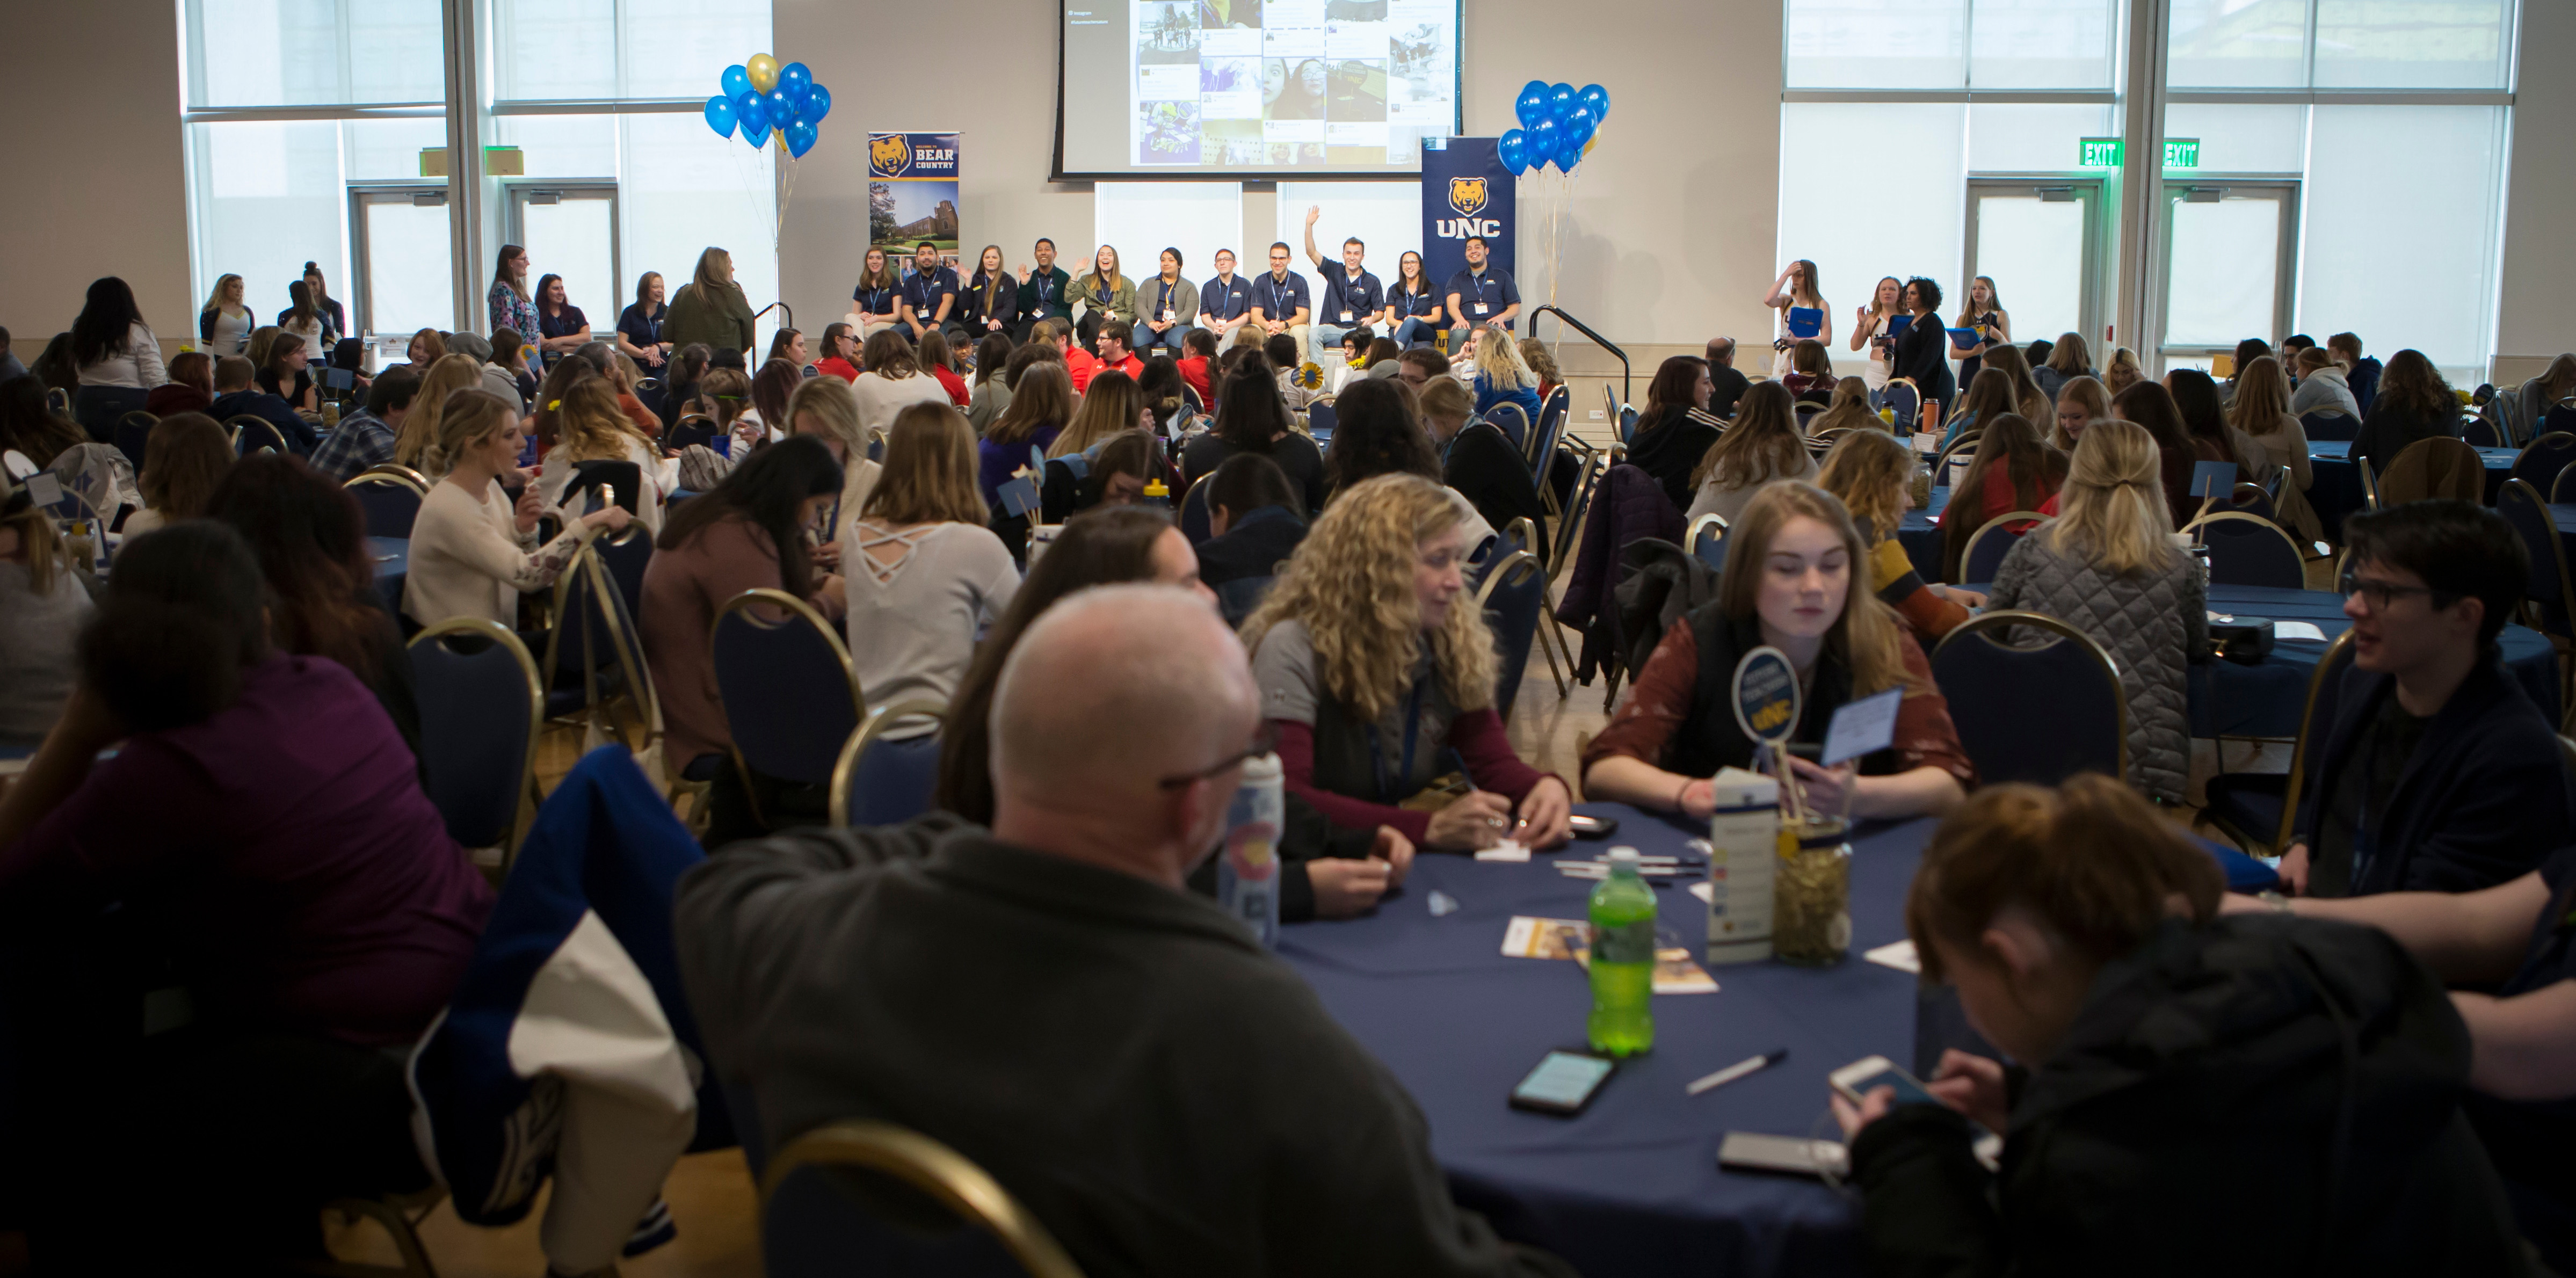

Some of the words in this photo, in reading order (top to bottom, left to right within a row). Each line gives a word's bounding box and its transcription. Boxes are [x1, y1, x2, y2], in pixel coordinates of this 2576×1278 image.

[916, 149, 954, 161] BEAR
[2085, 143, 2116, 165] EXIT
[2164, 143, 2196, 166] EXIT
[1436, 218, 1500, 239] UNC
